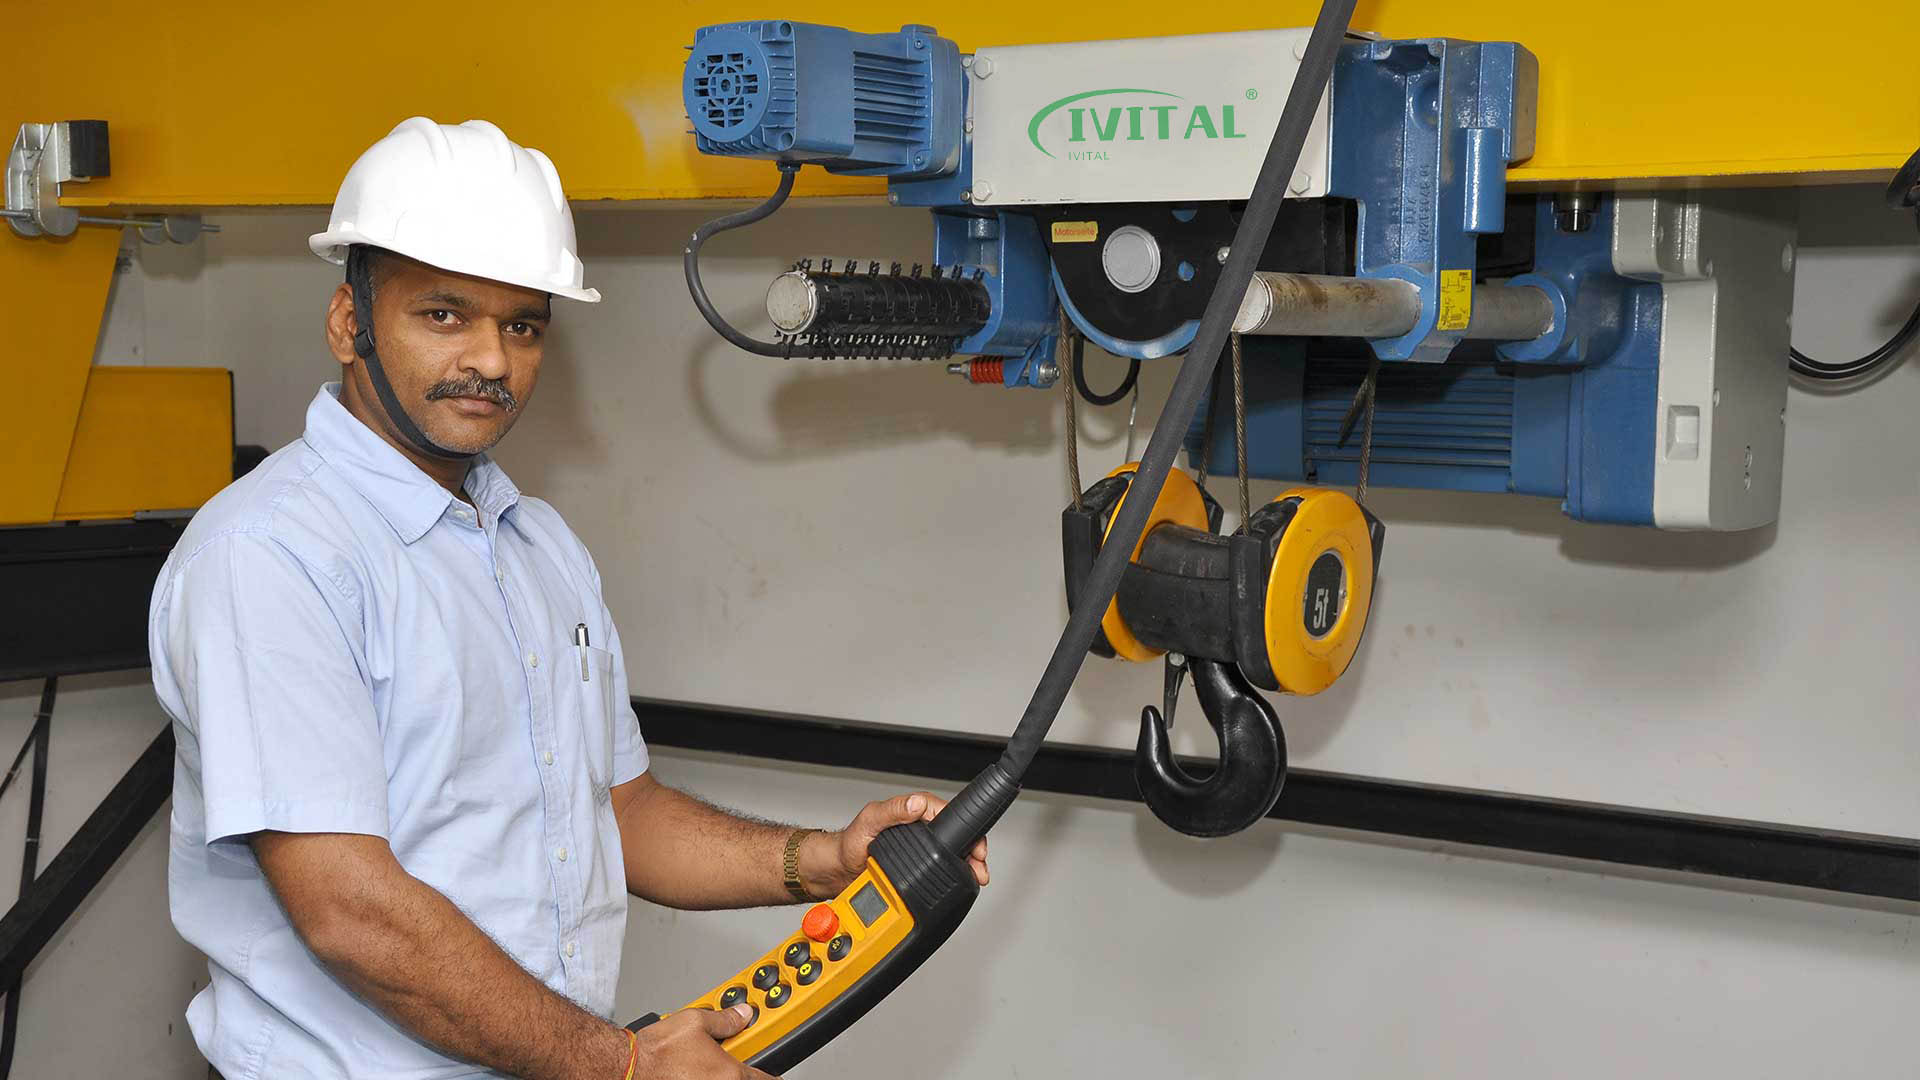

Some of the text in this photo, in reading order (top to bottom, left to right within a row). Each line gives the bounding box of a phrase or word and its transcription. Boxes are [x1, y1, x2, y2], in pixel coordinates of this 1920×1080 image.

[1068, 104, 1247, 142] IVITAL
[1068, 151, 1110, 161] IVITAL
[1313, 587, 1329, 629] 5t
